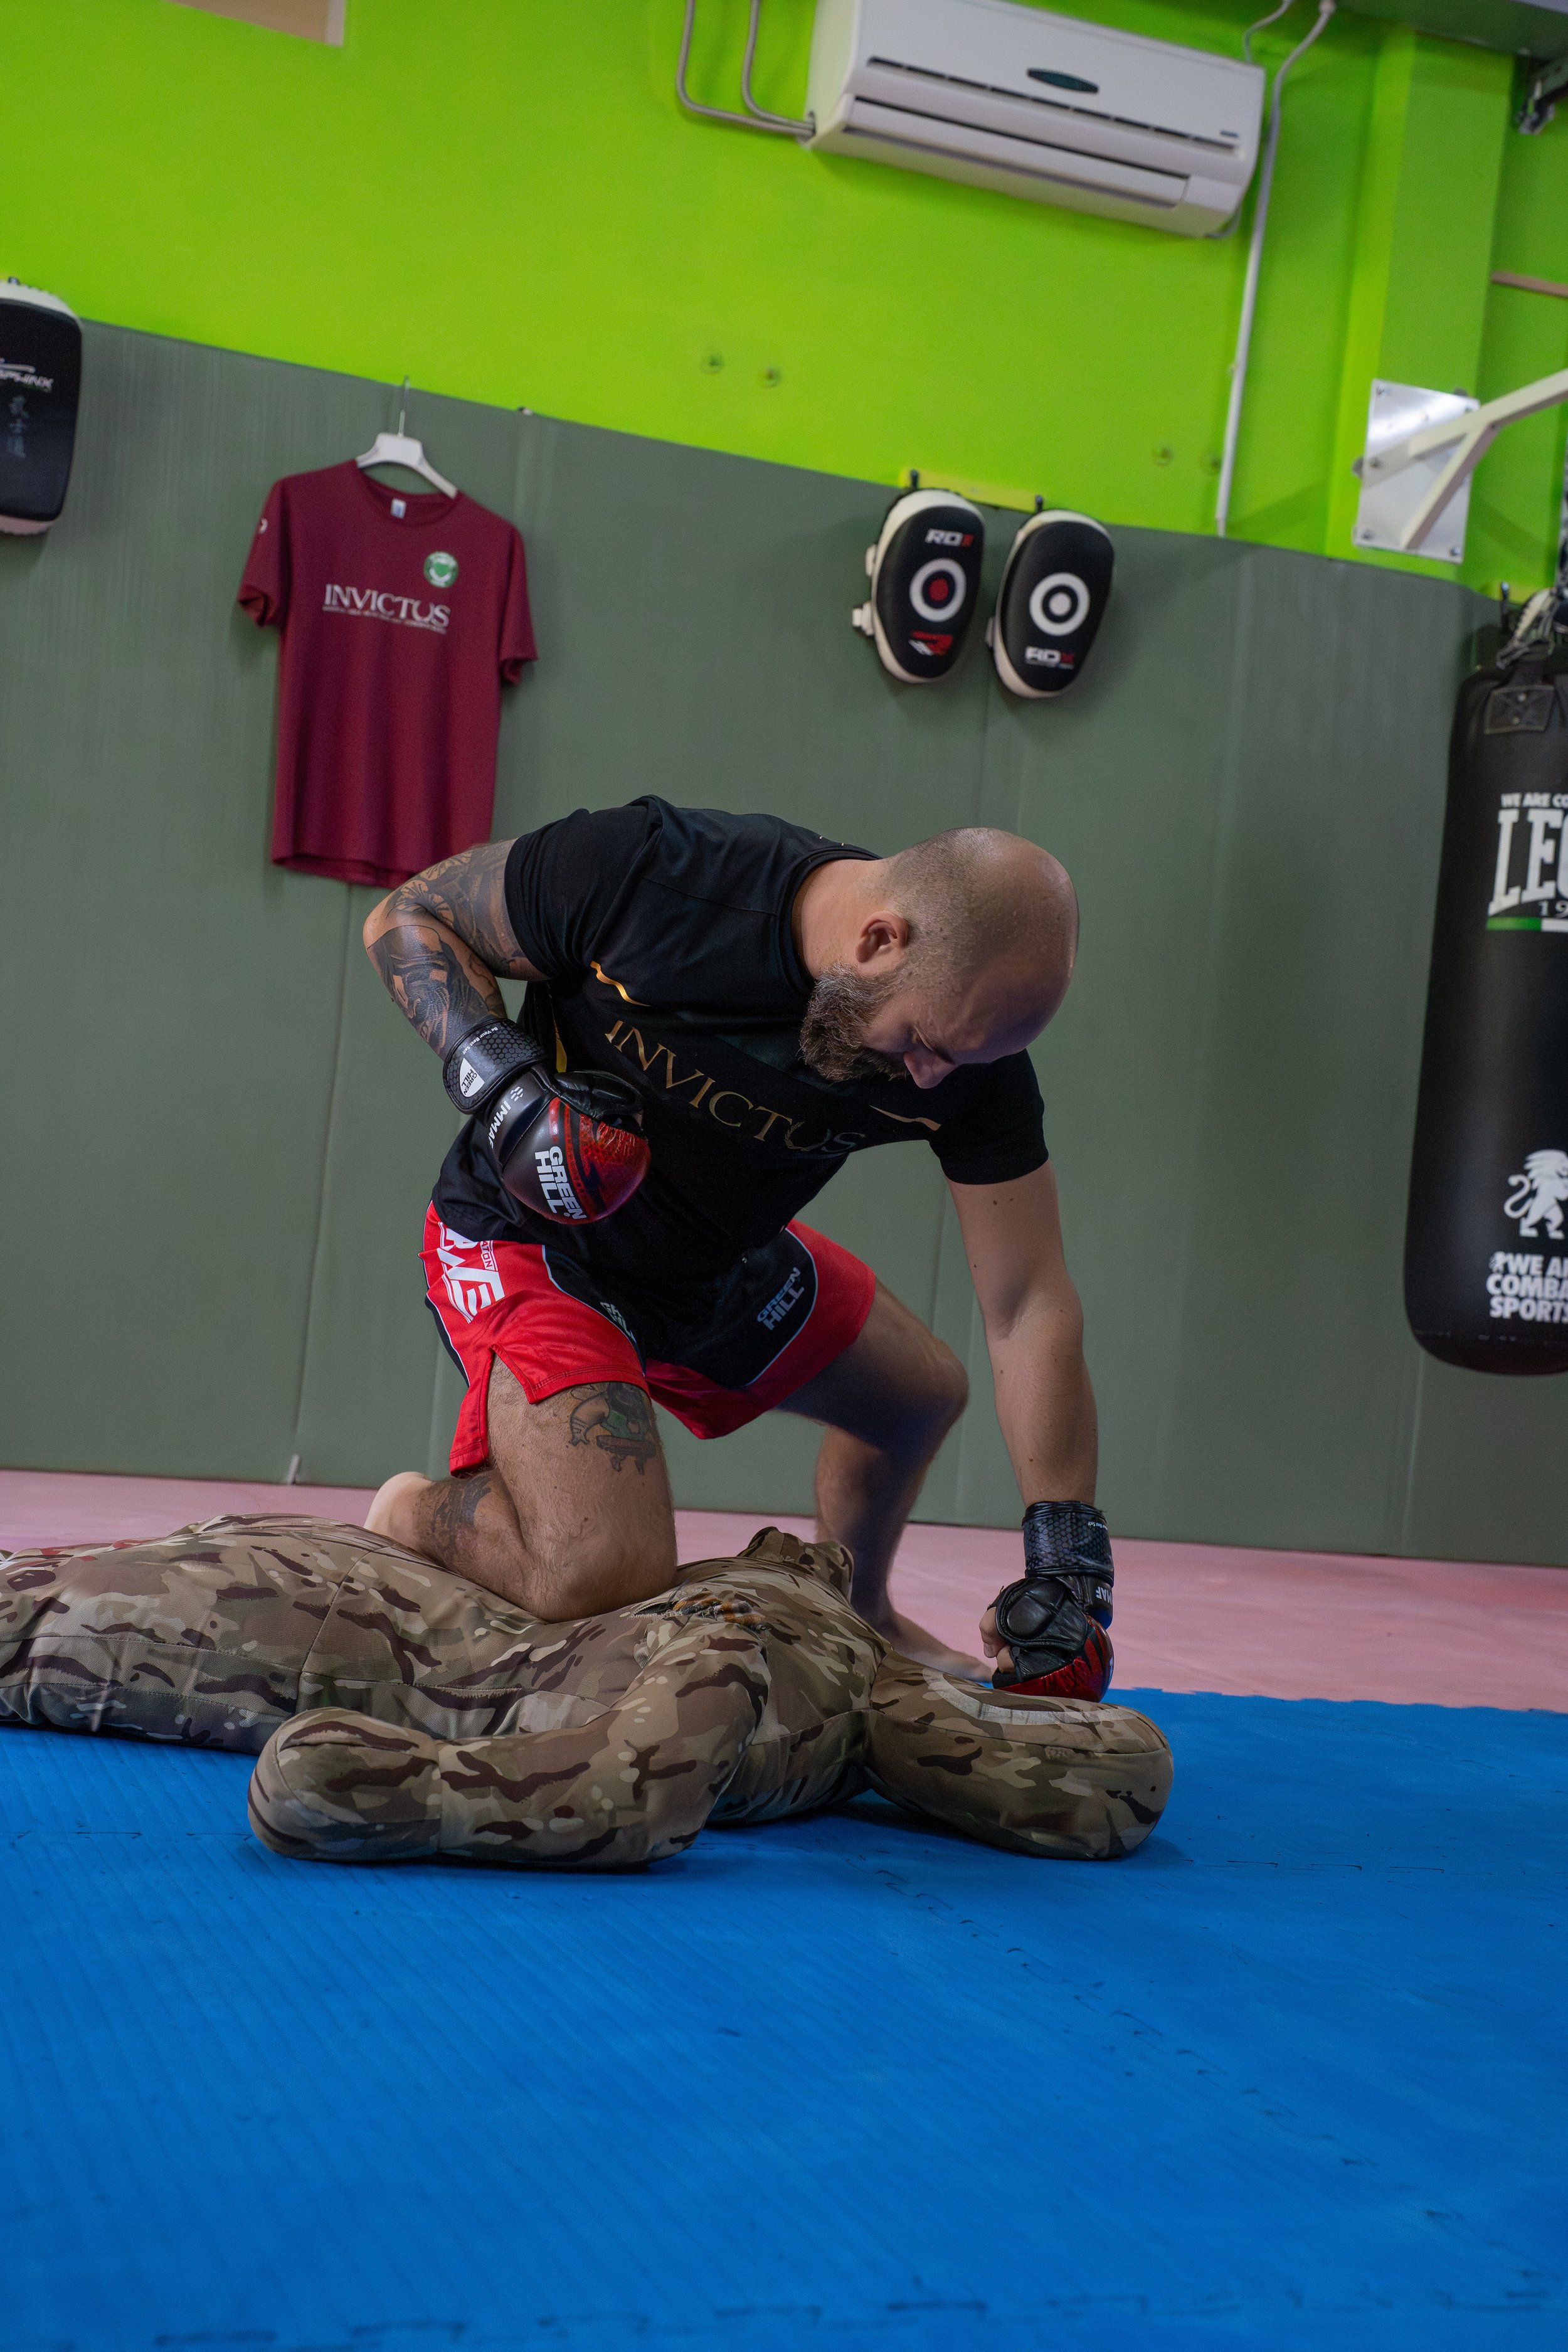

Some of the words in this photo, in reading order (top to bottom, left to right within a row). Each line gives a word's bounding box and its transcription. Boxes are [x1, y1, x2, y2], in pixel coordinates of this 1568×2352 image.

[324, 583, 451, 628] INVICTUS
[462, 1046, 470, 1054] Self
[470, 1037, 480, 1046] Best
[462, 1069, 474, 1086] HILL
[464, 1073, 477, 1095] GREEN
[605, 1020, 866, 1152] INVICTUS
[535, 1150, 564, 1214] HILL
[549, 1146, 587, 1219] GREEN
[763, 1286, 805, 1330] HILL
